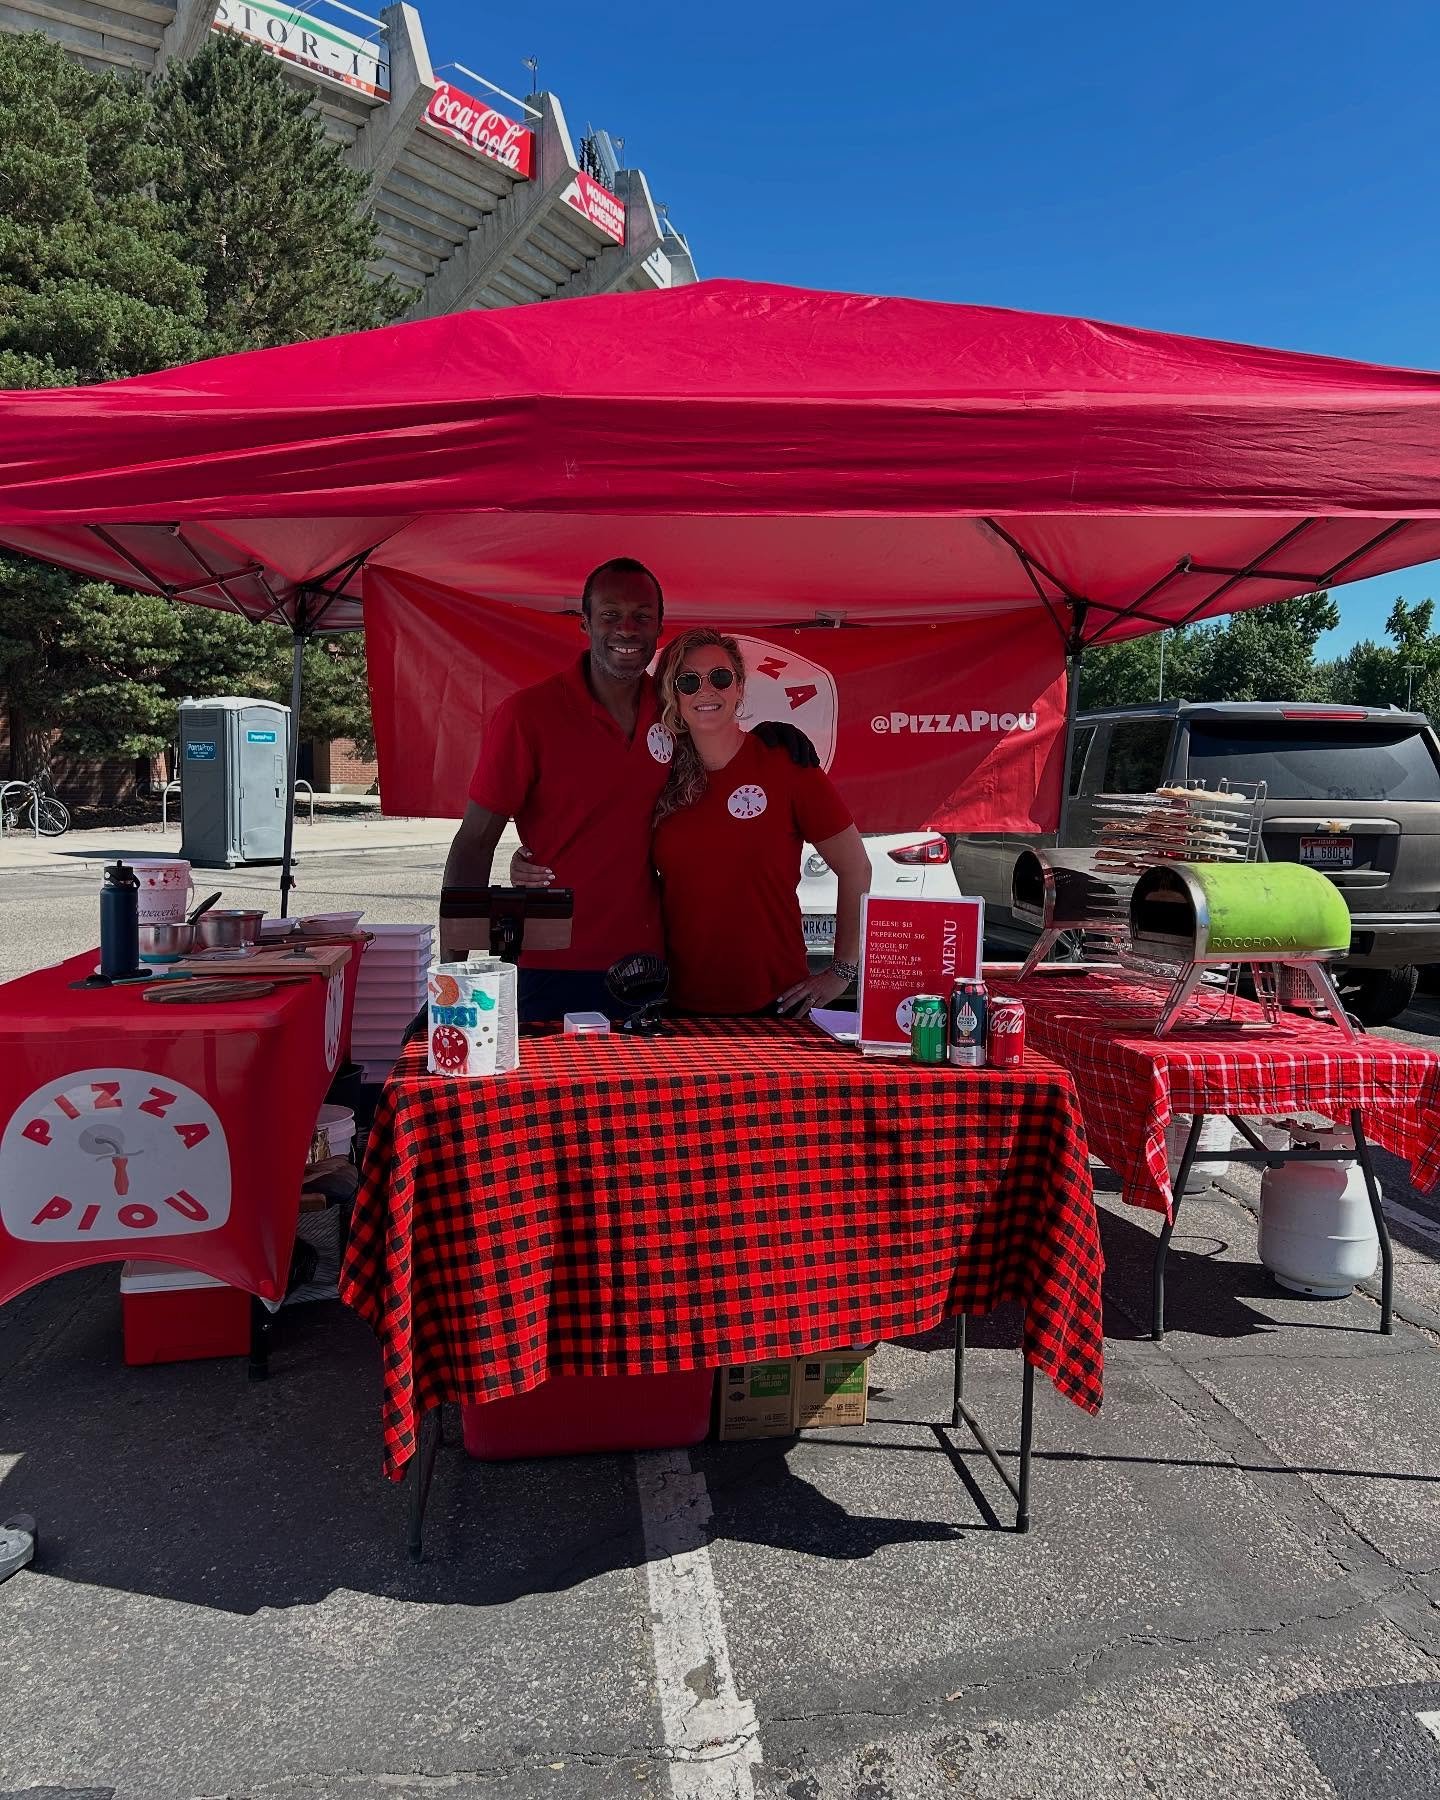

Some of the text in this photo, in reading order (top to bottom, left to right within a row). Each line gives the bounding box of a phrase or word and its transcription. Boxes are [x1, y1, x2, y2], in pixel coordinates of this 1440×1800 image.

[588, 200, 623, 239] AMERICA
[732, 787, 764, 800] PIZZA
[734, 805, 762, 817] PIOU
[870, 931, 911, 939] PEPPERONI
[942, 919, 957, 977] MENU
[869, 953, 908, 961] HAWAIIAN
[890, 980, 915, 988] SAUCE
[435, 1028, 464, 1047] PIZZA
[436, 1051, 460, 1067] PIOU
[20, 1081, 211, 1150] PIZZA
[31, 1189, 210, 1231] PIOU
